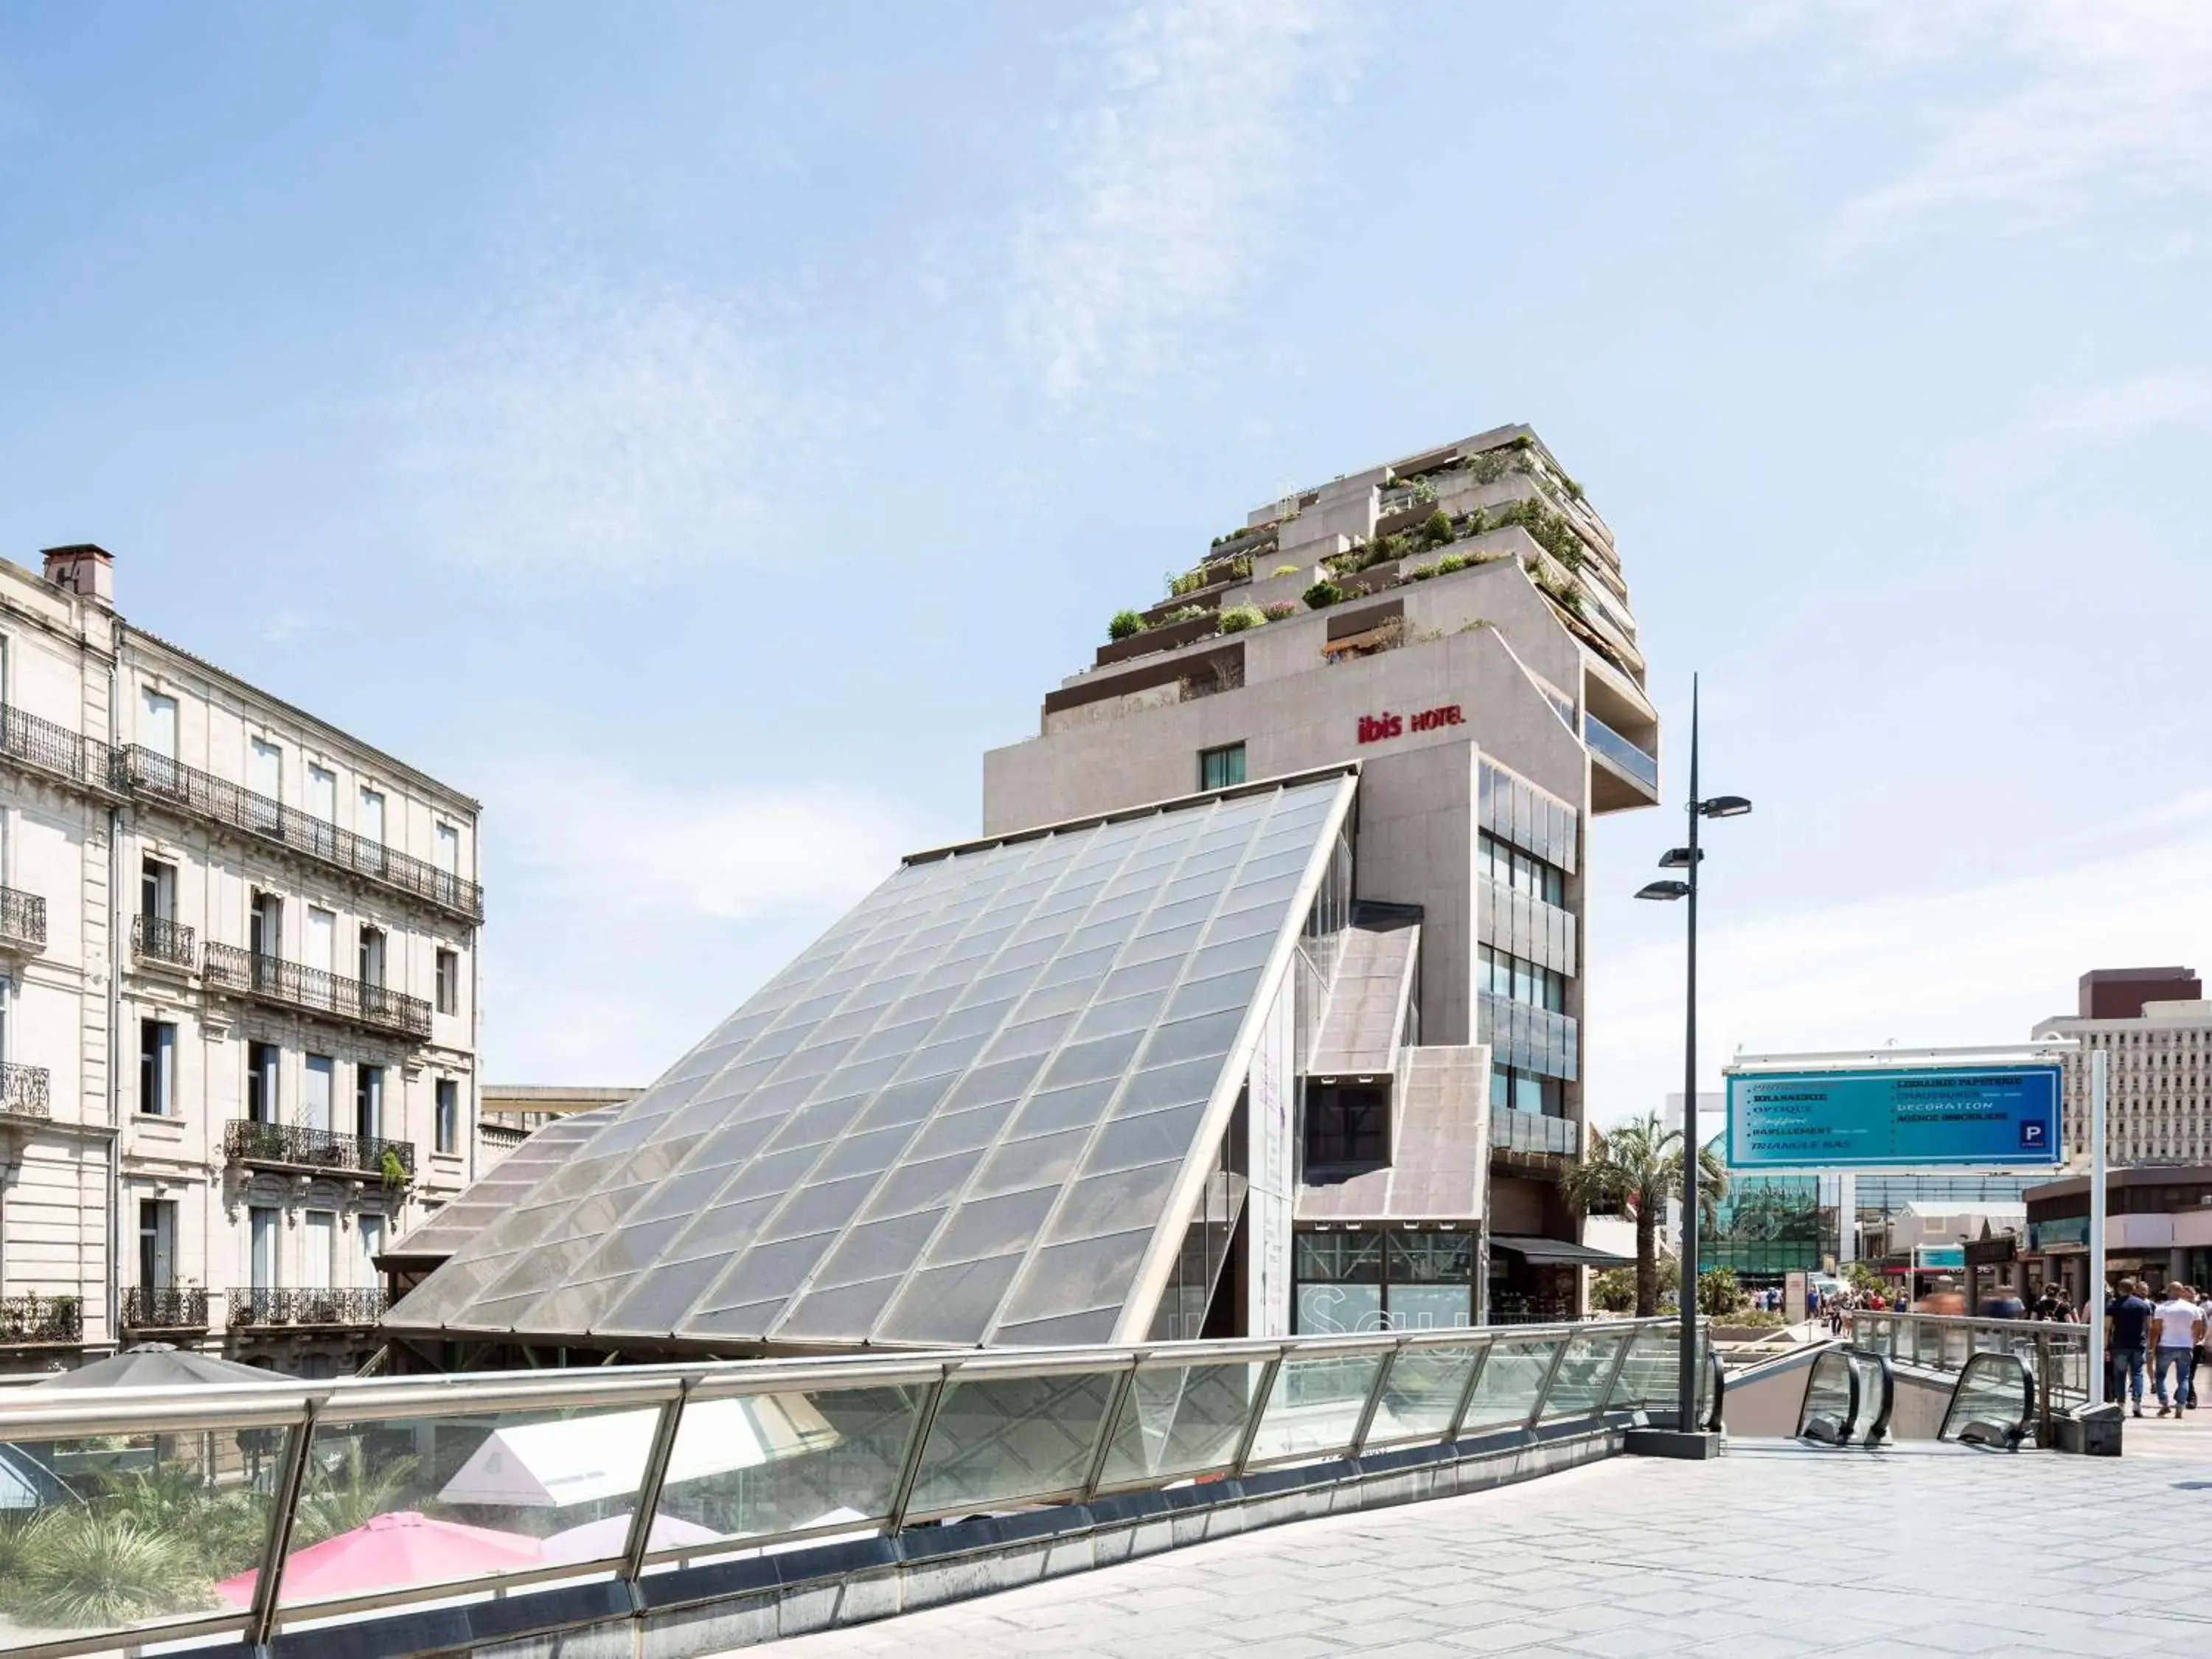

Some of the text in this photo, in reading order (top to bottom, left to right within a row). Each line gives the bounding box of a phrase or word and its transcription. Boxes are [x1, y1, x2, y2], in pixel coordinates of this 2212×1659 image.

[1358, 704, 1466, 744] ibis HOTEL
[1896, 1102, 1993, 1111] DECORATION
[2026, 1126, 2041, 1141] P
